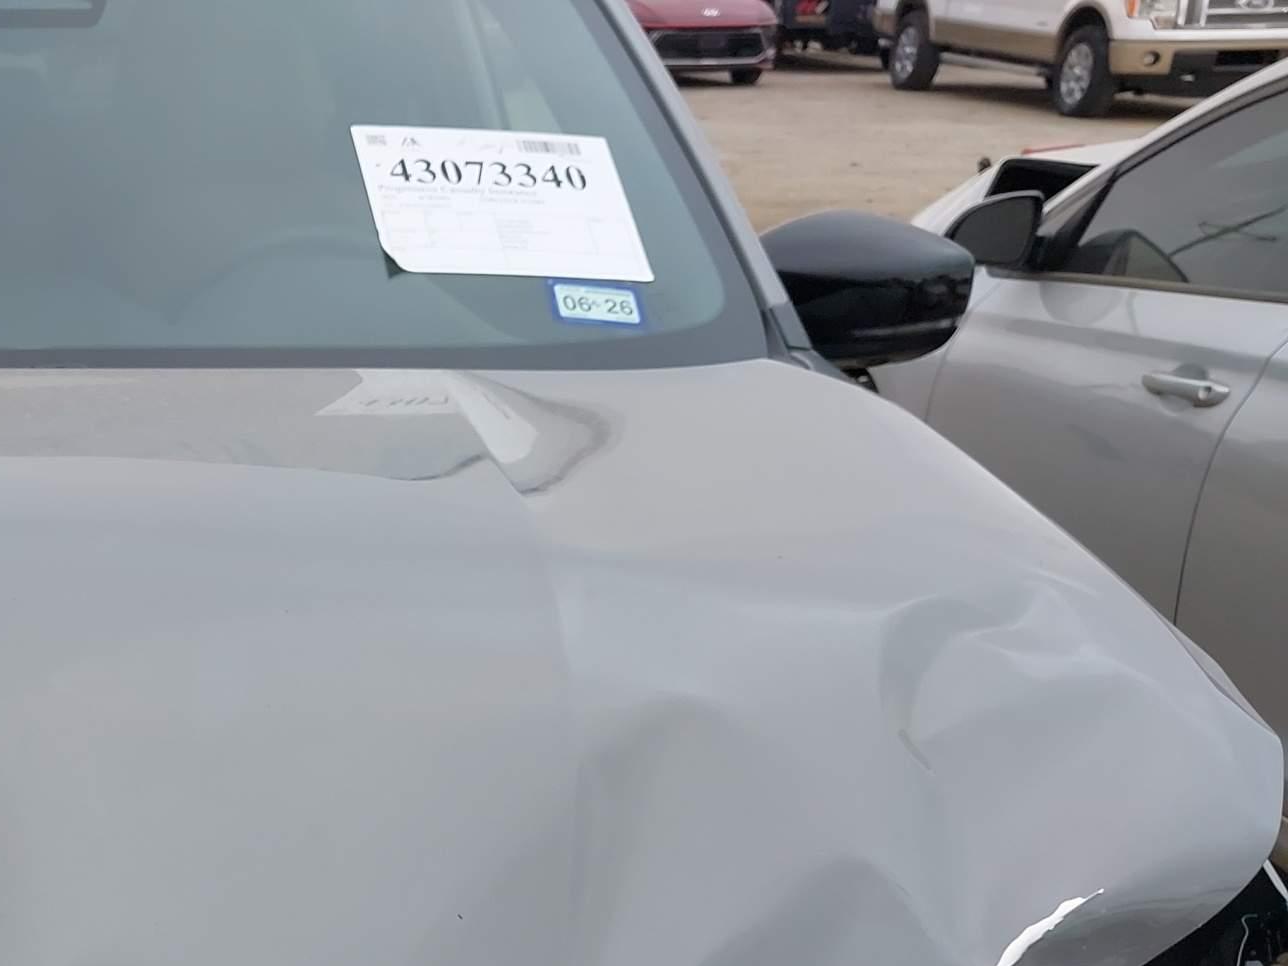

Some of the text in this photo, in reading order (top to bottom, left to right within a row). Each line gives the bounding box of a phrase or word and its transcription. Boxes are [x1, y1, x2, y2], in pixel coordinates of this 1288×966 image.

[390, 157, 588, 190] 43073340
[561, 293, 633, 316] 06 26
